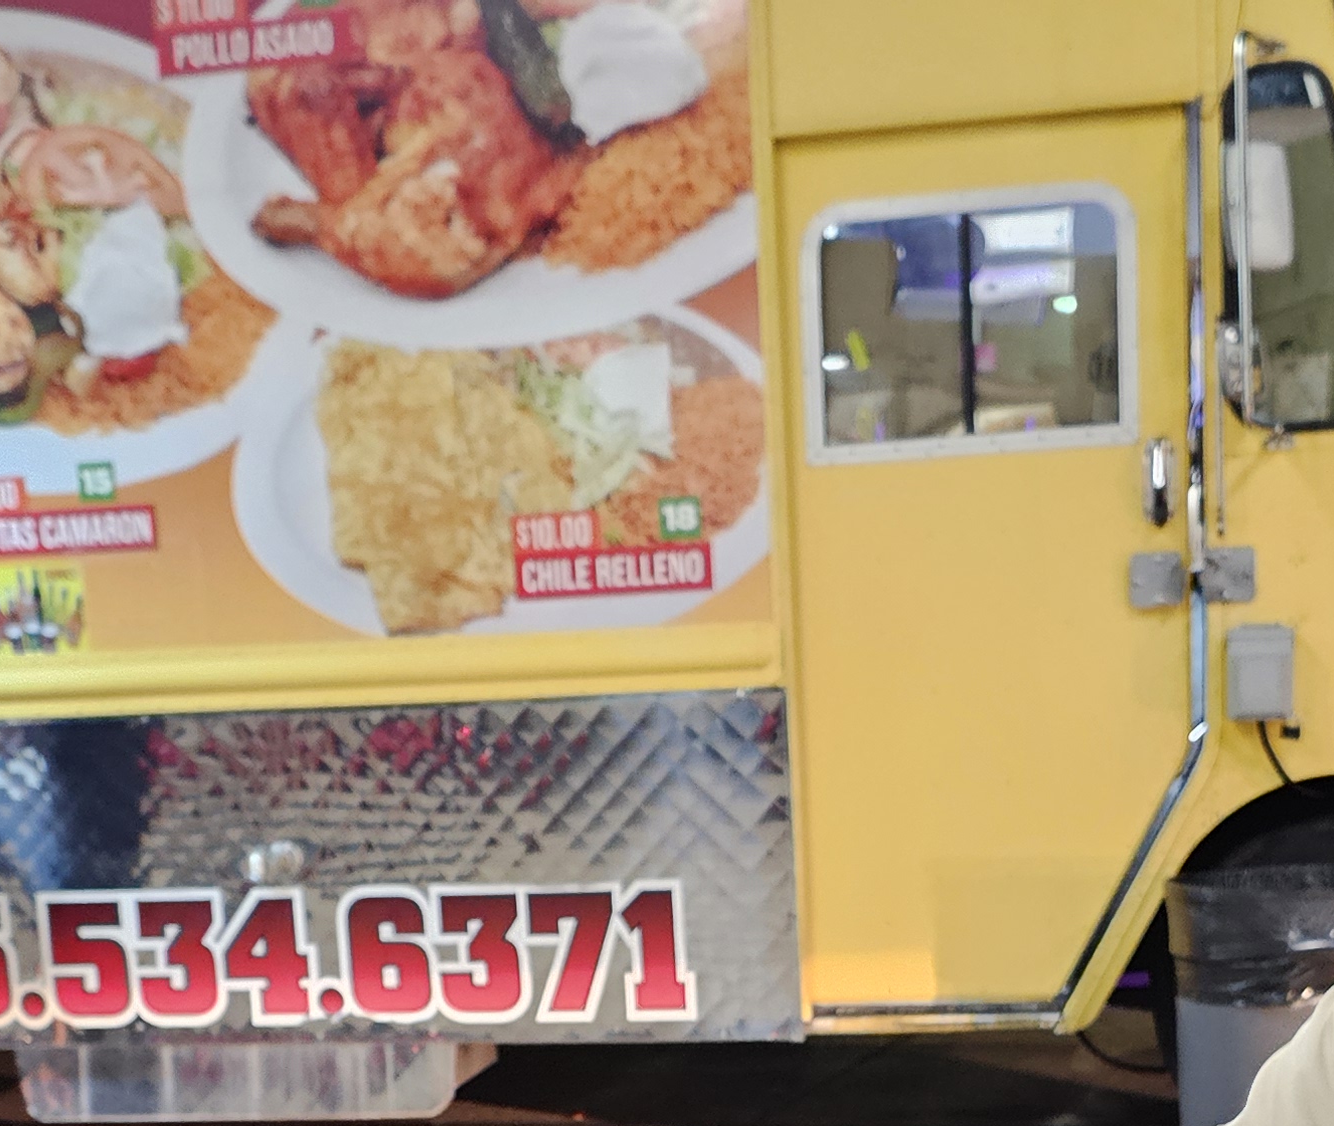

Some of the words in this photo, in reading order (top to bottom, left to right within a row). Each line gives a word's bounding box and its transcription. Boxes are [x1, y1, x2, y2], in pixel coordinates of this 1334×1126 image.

[171, 27, 251, 70] POLLO
[251, 18, 335, 61] ASADO
[39, 510, 154, 550] CAMARON
[516, 514, 593, 550] $10.00
[521, 555, 593, 593] CHILE
[594, 550, 706, 589] RELLENO
